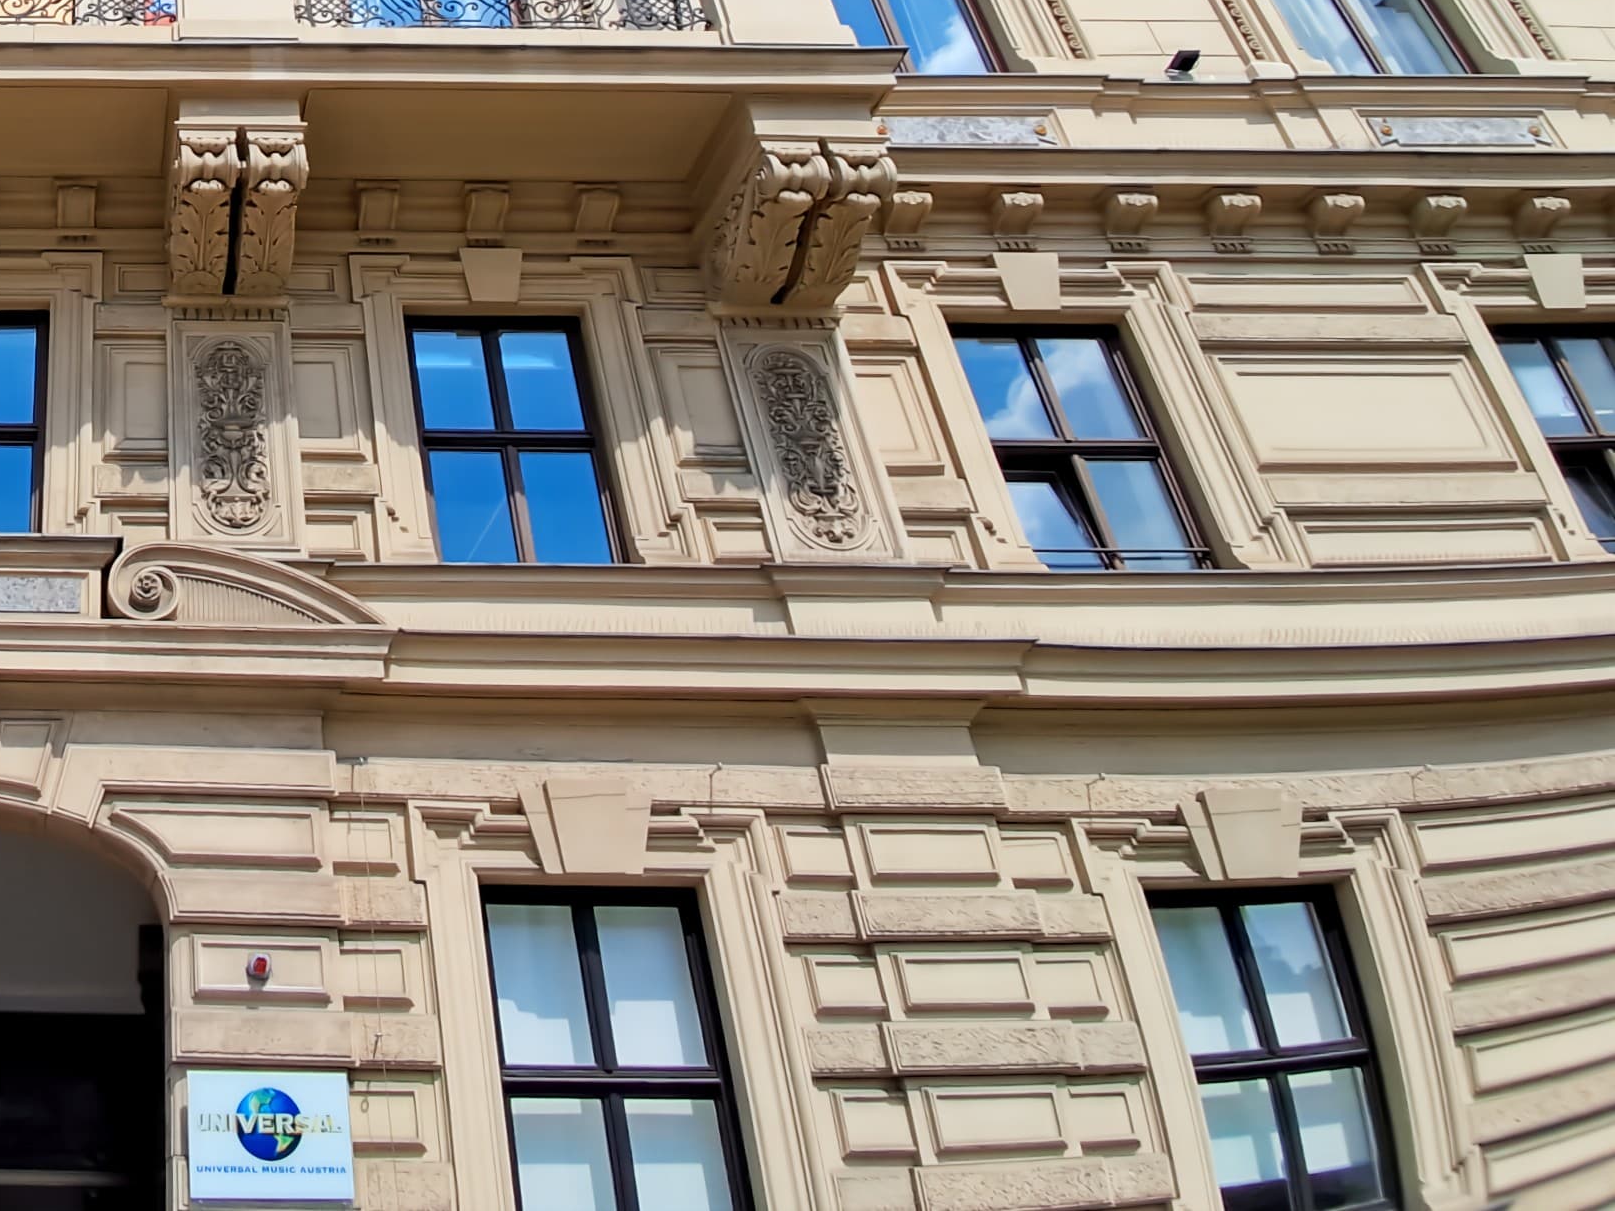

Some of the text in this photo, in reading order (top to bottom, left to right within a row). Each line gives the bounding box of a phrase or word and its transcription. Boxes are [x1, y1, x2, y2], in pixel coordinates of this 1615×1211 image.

[198, 1113, 343, 1134] UNIVERSAL
[196, 1165, 347, 1174] UNIVERSAL MUSIC AUSTRIA
